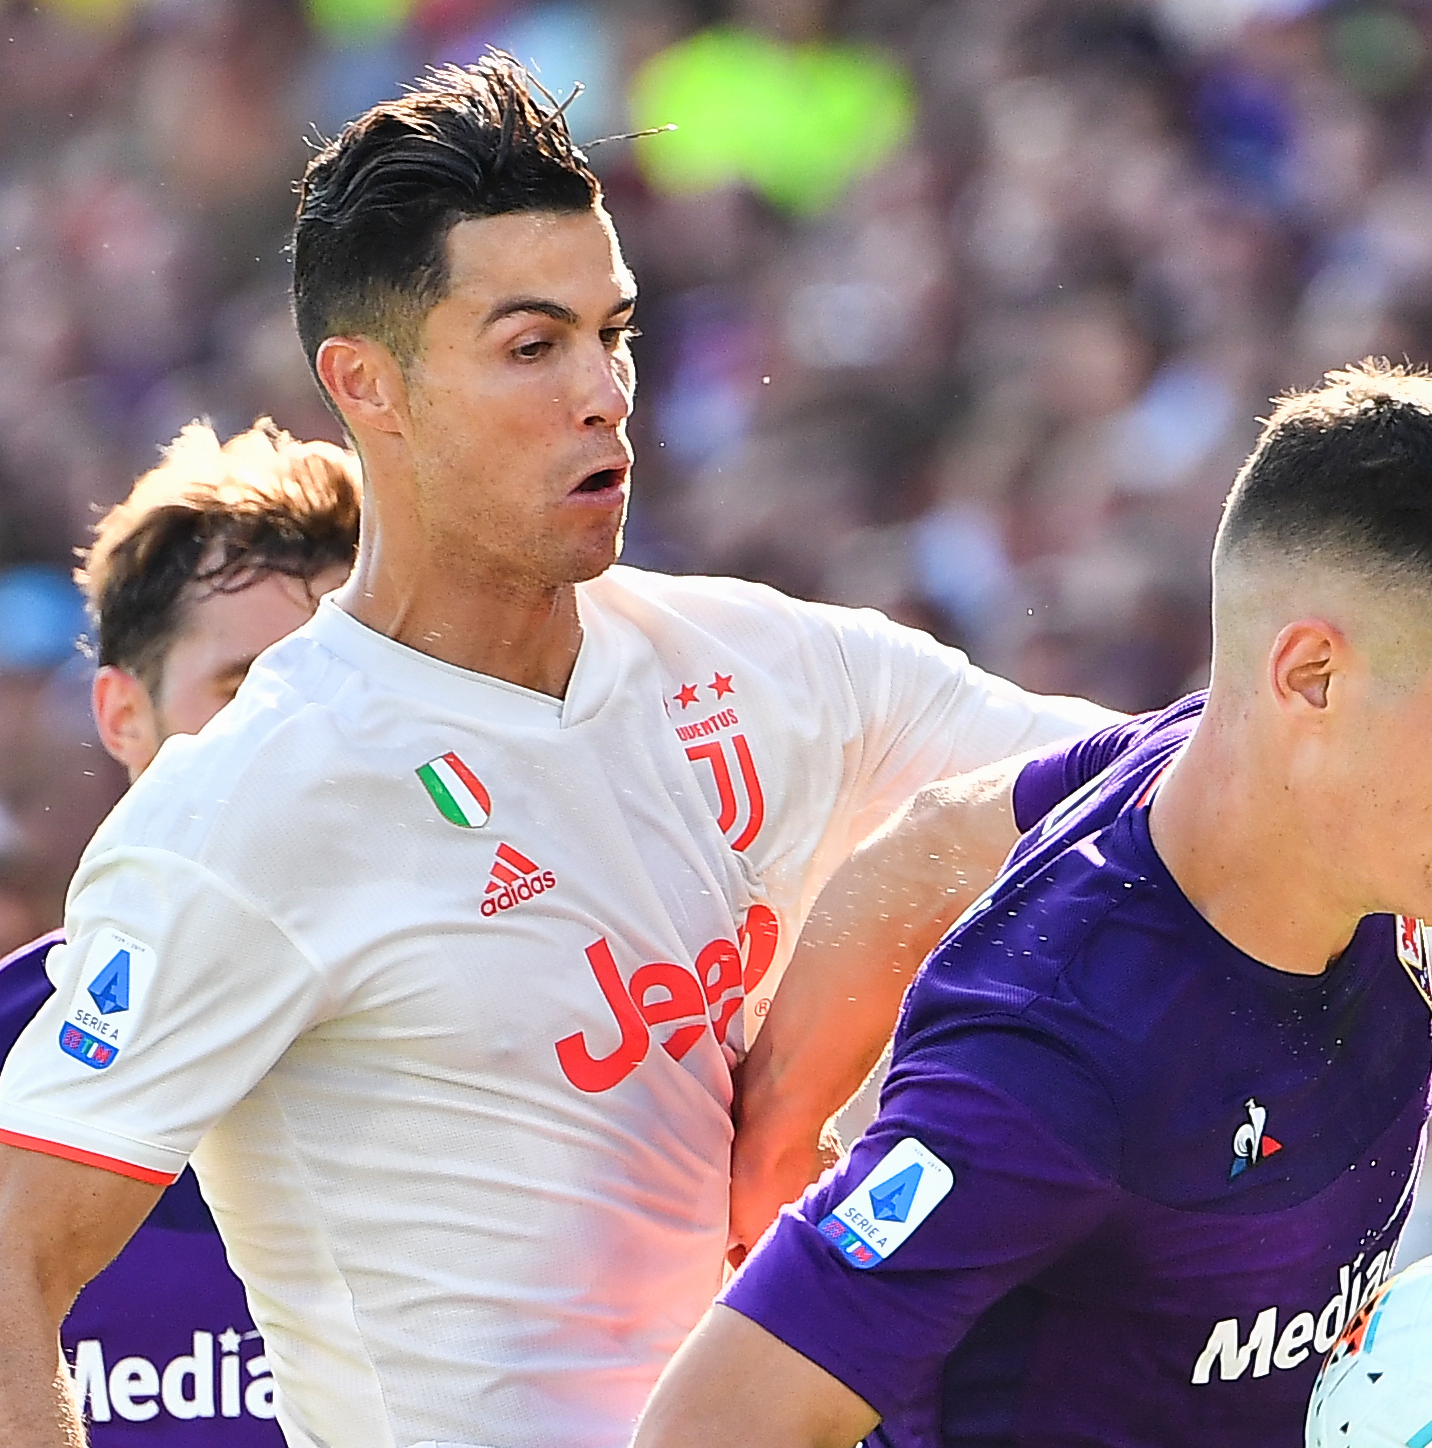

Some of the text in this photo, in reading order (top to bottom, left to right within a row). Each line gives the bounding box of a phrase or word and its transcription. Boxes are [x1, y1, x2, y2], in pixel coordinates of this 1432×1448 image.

[675, 708, 739, 741] UVENTUS
[480, 870, 556, 917] adidas
[74, 1009, 120, 1041] SERIE A
[81, 1038, 112, 1064] TIM
[844, 1207, 888, 1248] SERIE A
[840, 1232, 874, 1263] TIM
[1191, 1240, 1398, 1384] Media
